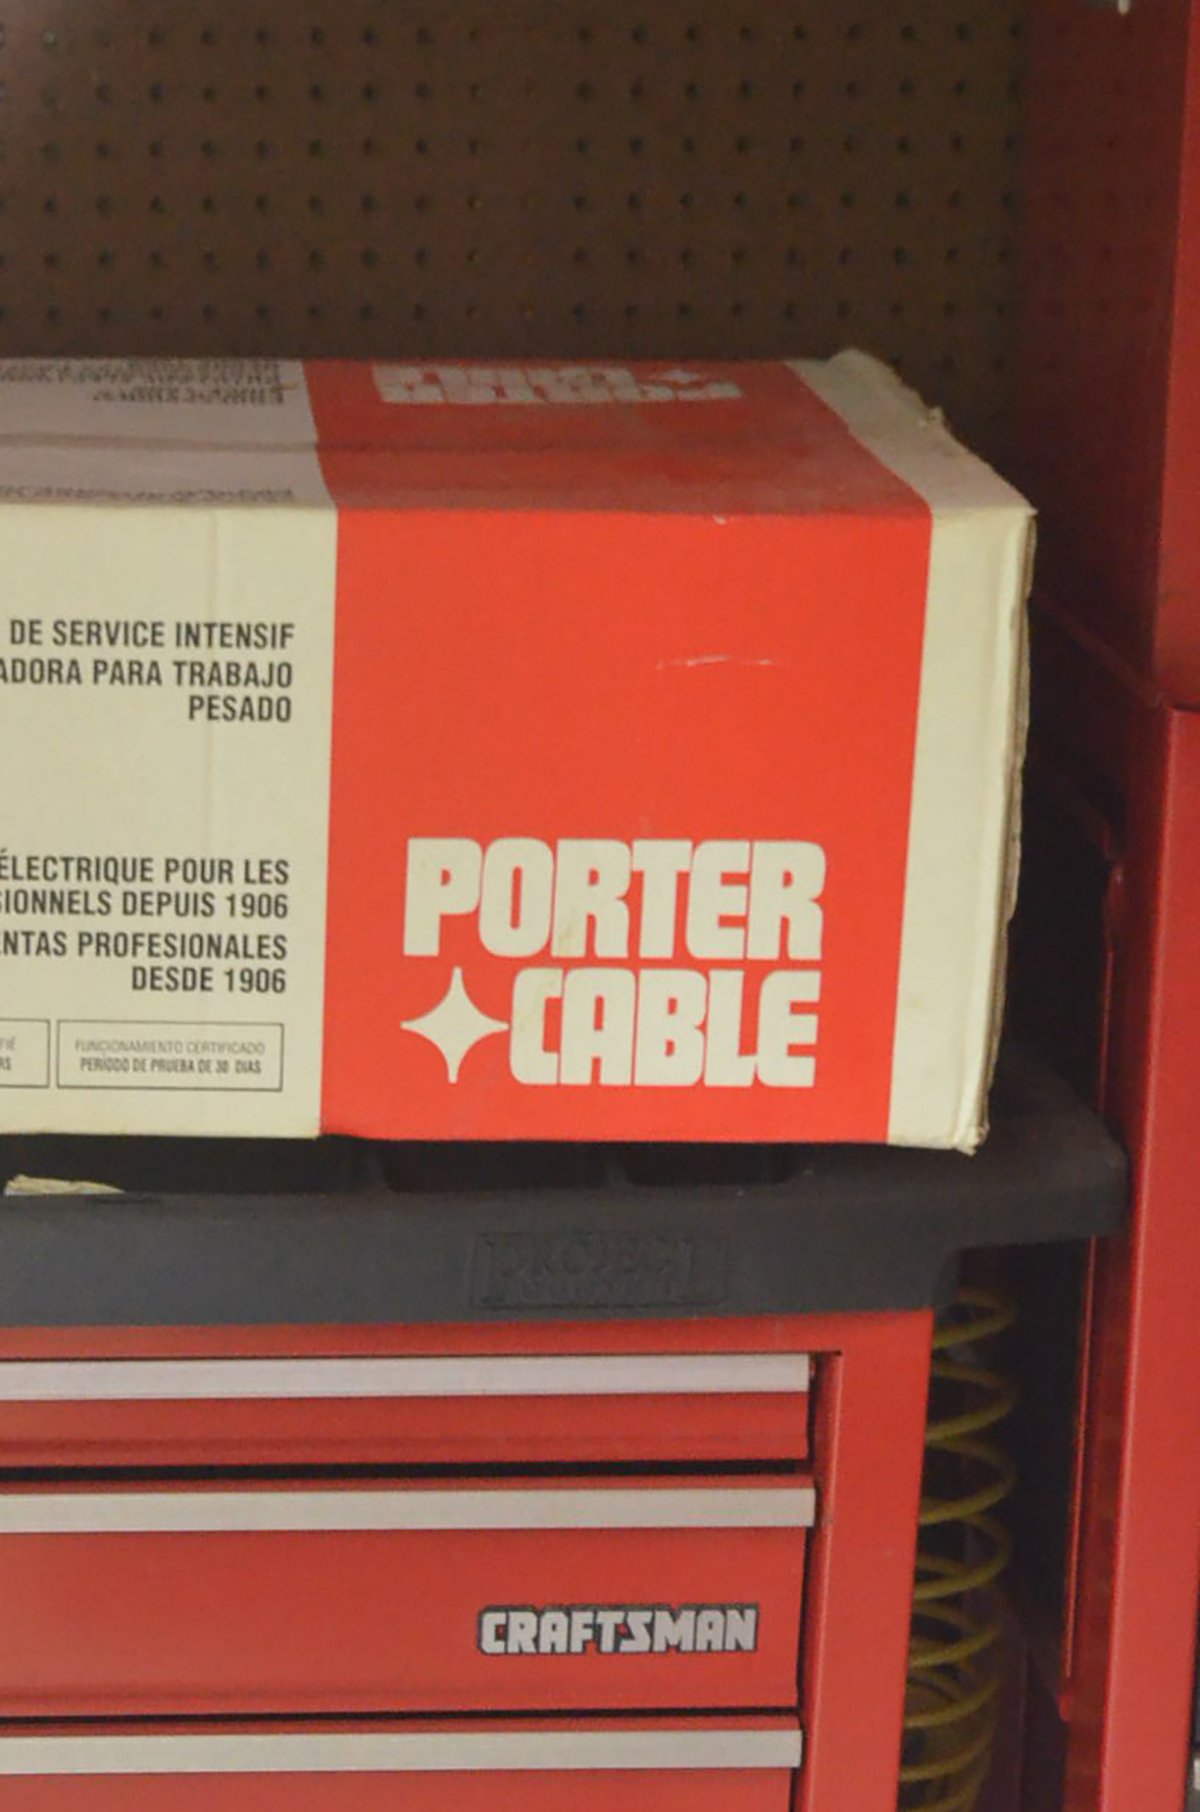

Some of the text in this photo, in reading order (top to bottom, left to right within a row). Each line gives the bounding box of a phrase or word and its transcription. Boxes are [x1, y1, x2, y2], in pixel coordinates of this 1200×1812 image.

[9, 618, 43, 646] DE
[52, 619, 165, 648] SERVICE
[175, 621, 295, 650] INTENSIF
[92, 658, 163, 686] PARA
[172, 660, 293, 689] TRABAJO
[188, 694, 292, 723] PESADO
[164, 857, 234, 885] POUR
[243, 858, 289, 886] LES
[122, 890, 215, 918] DEPUIS
[226, 892, 289, 919] 1906
[403, 836, 827, 961] PORTER
[77, 931, 287, 961] PROFESIONALES
[131, 965, 286, 994] DESDE 1906
[509, 967, 822, 1088] CABLE
[133, 1058, 147, 1072] DE
[150, 1058, 194, 1073] PRUEBA
[198, 1059, 212, 1073] DE
[477, 1604, 758, 1655] CRAFTSMAN
